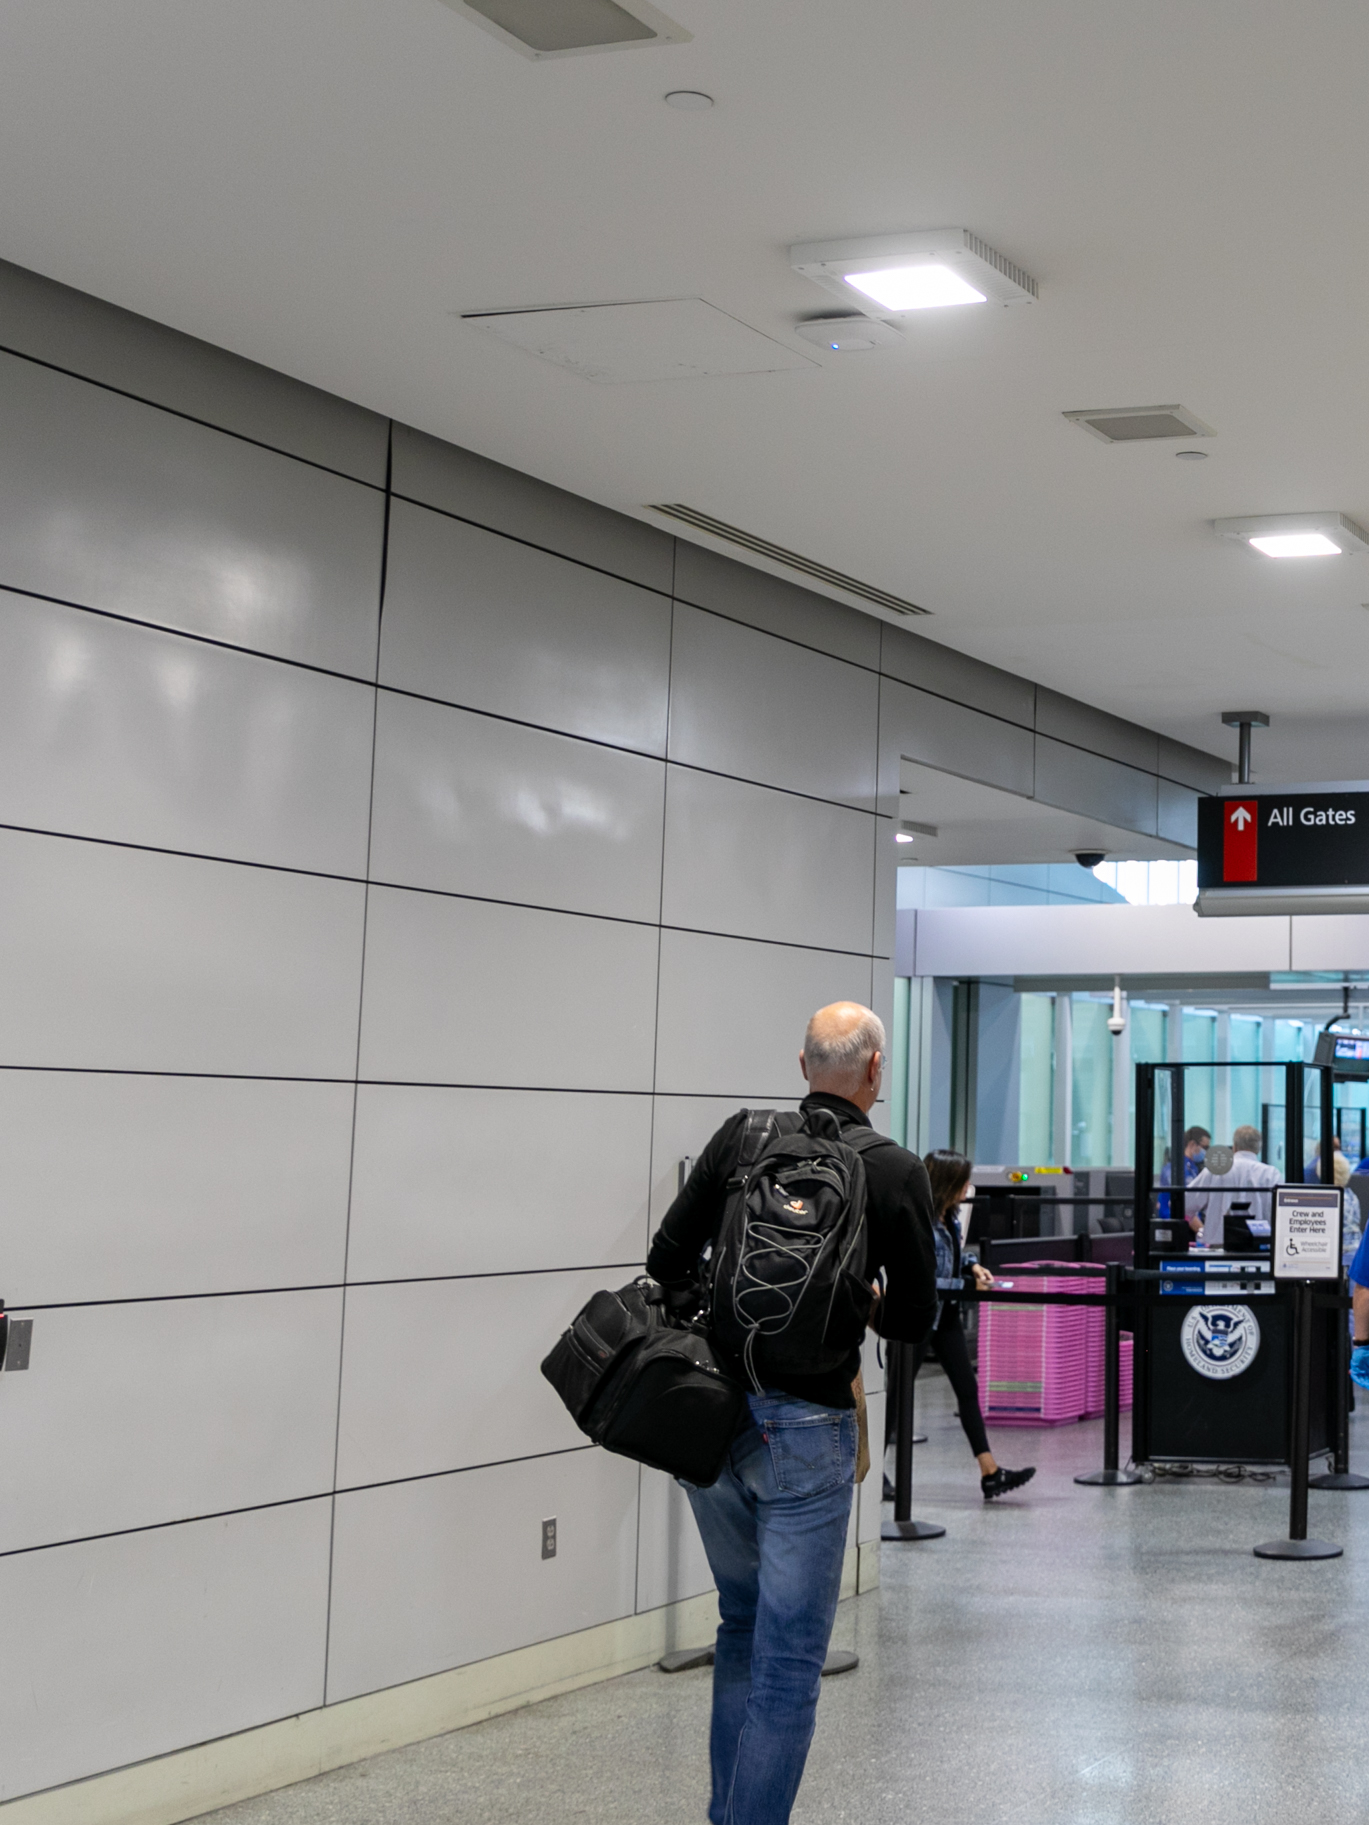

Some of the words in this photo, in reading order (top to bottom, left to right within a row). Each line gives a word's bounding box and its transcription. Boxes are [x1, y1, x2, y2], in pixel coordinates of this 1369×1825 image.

[1267, 806, 1293, 827] All
[1299, 807, 1356, 826] Gates
[1291, 1210, 1310, 1218] Crew
[1311, 1210, 1324, 1218] and
[1288, 1218, 1327, 1227] Employees
[1289, 1225, 1308, 1233] Enter
[1309, 1226, 1326, 1234] Here
[1185, 1337, 1219, 1375] HOMELAND
[1220, 1345, 1254, 1375] SECURITY
